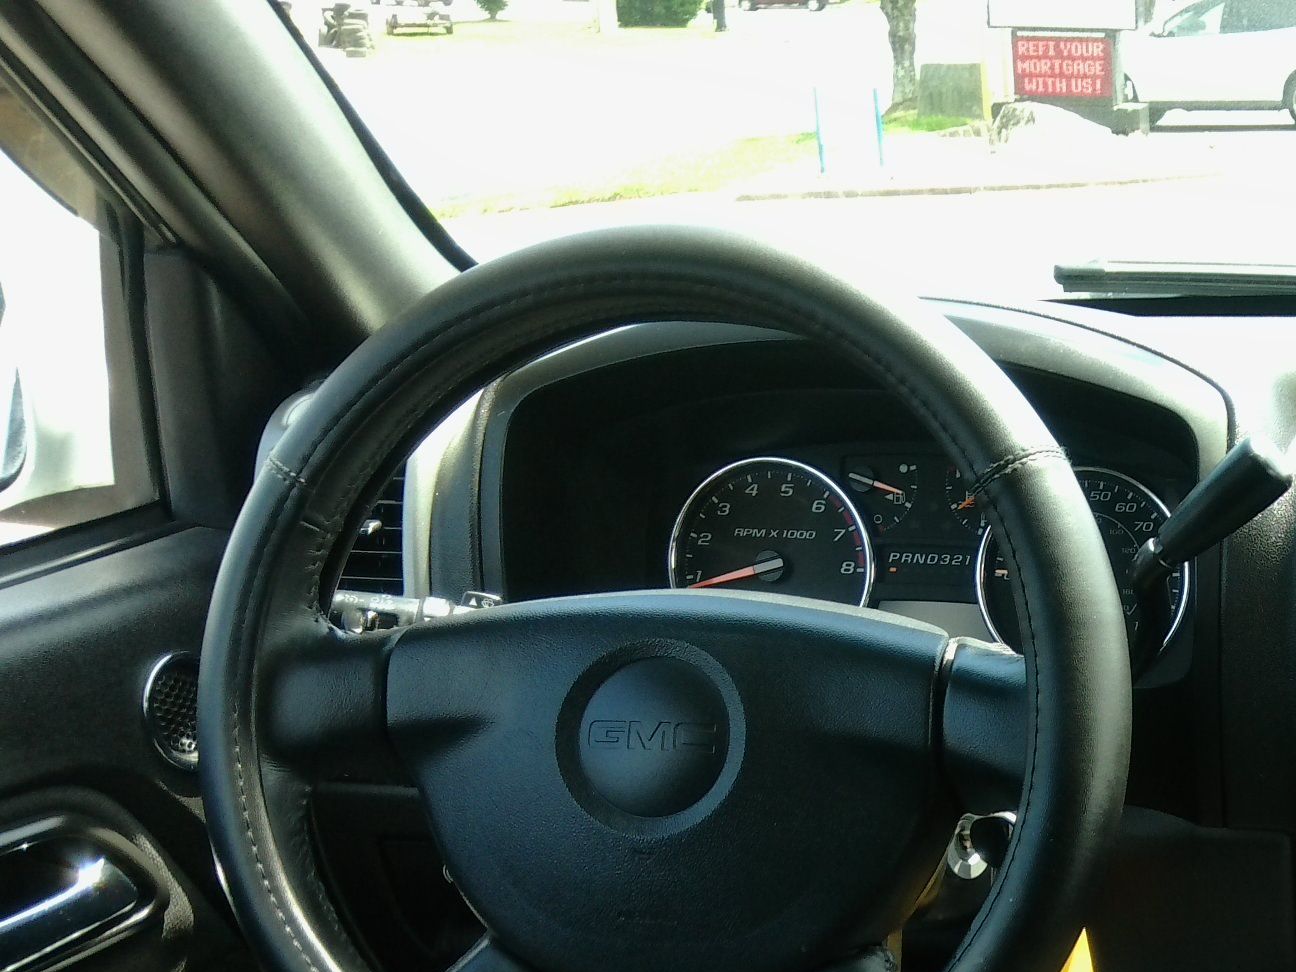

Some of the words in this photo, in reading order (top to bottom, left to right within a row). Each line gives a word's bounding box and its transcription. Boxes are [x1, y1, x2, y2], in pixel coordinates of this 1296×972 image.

[1017, 40, 1056, 57] REFI
[1059, 41, 1105, 57] YOUR
[1016, 58, 1106, 75] MORTGAGE
[1023, 76, 1067, 93] WITH
[1070, 77, 1102, 94] US!
[744, 483, 759, 497] 4
[779, 483, 794, 497] 5
[1089, 490, 1112, 502] 50
[717, 502, 731, 516] 3
[811, 499, 827, 513] 6
[1114, 502, 1138, 513] 60
[733, 527, 767, 538] RPM
[781, 529, 817, 540] 1000
[1132, 521, 1154, 532] 70
[697, 532, 712, 546] 2
[832, 528, 847, 542] 7
[840, 561, 855, 575] 8
[587, 719, 718, 756] GMC
